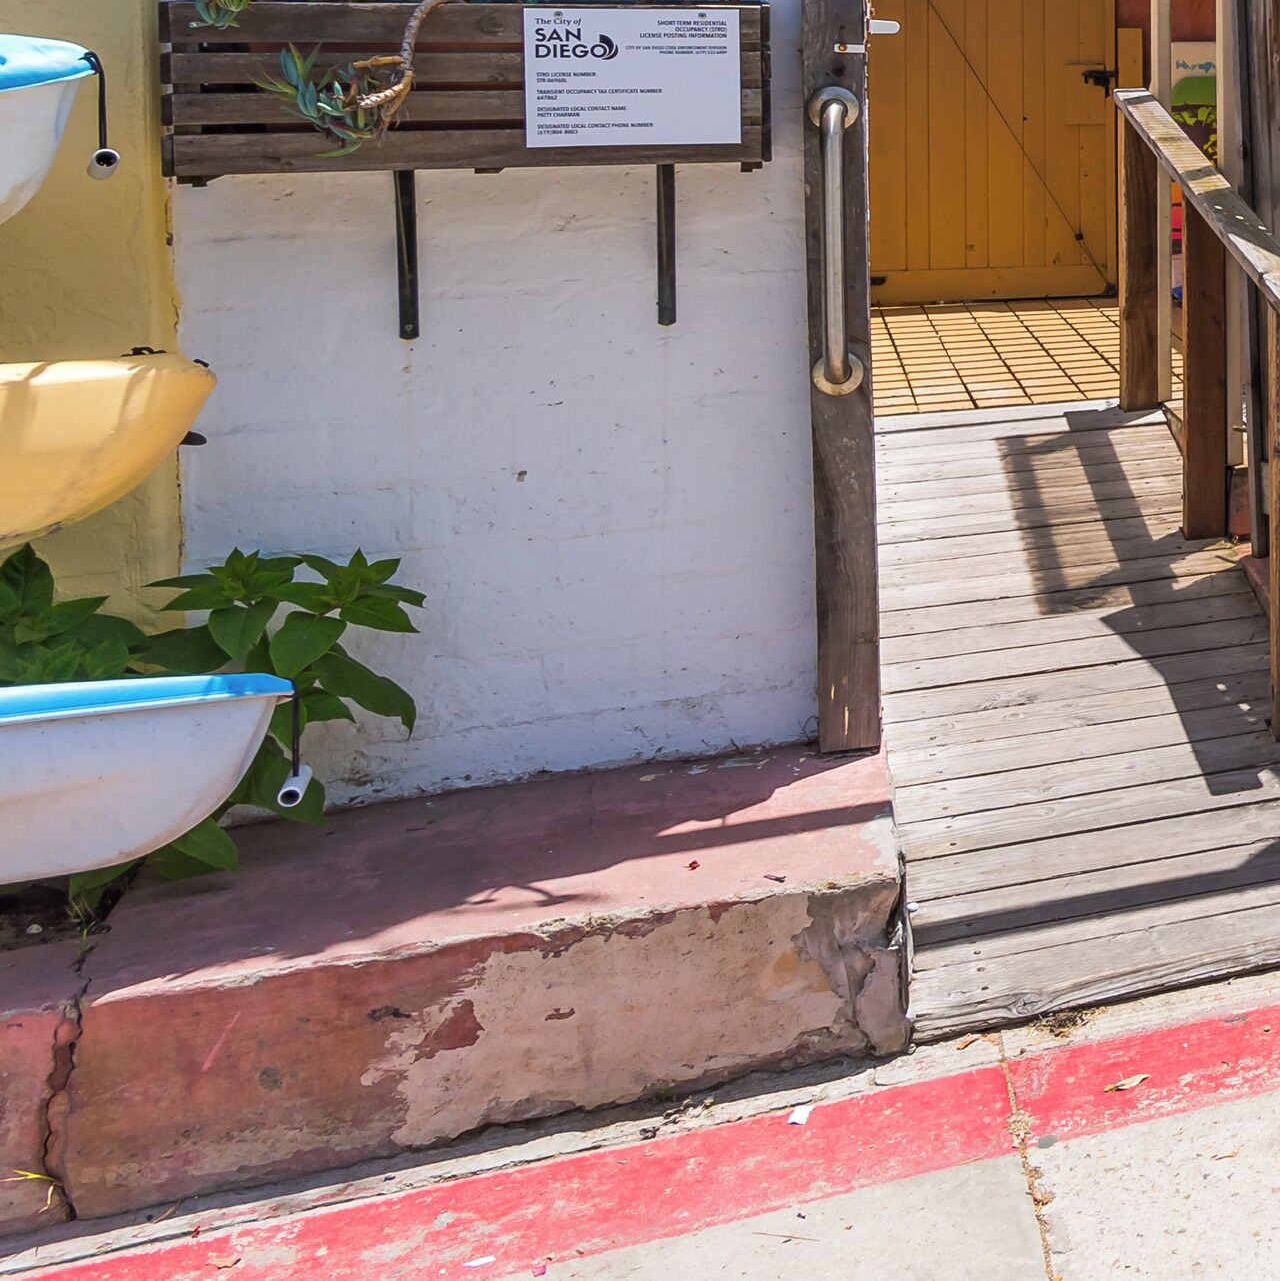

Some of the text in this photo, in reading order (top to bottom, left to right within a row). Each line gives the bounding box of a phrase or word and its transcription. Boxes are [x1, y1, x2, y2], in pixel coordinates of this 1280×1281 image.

[534, 17, 582, 26] The City of
[534, 27, 582, 42] SAN
[535, 43, 608, 58] DIEGO
